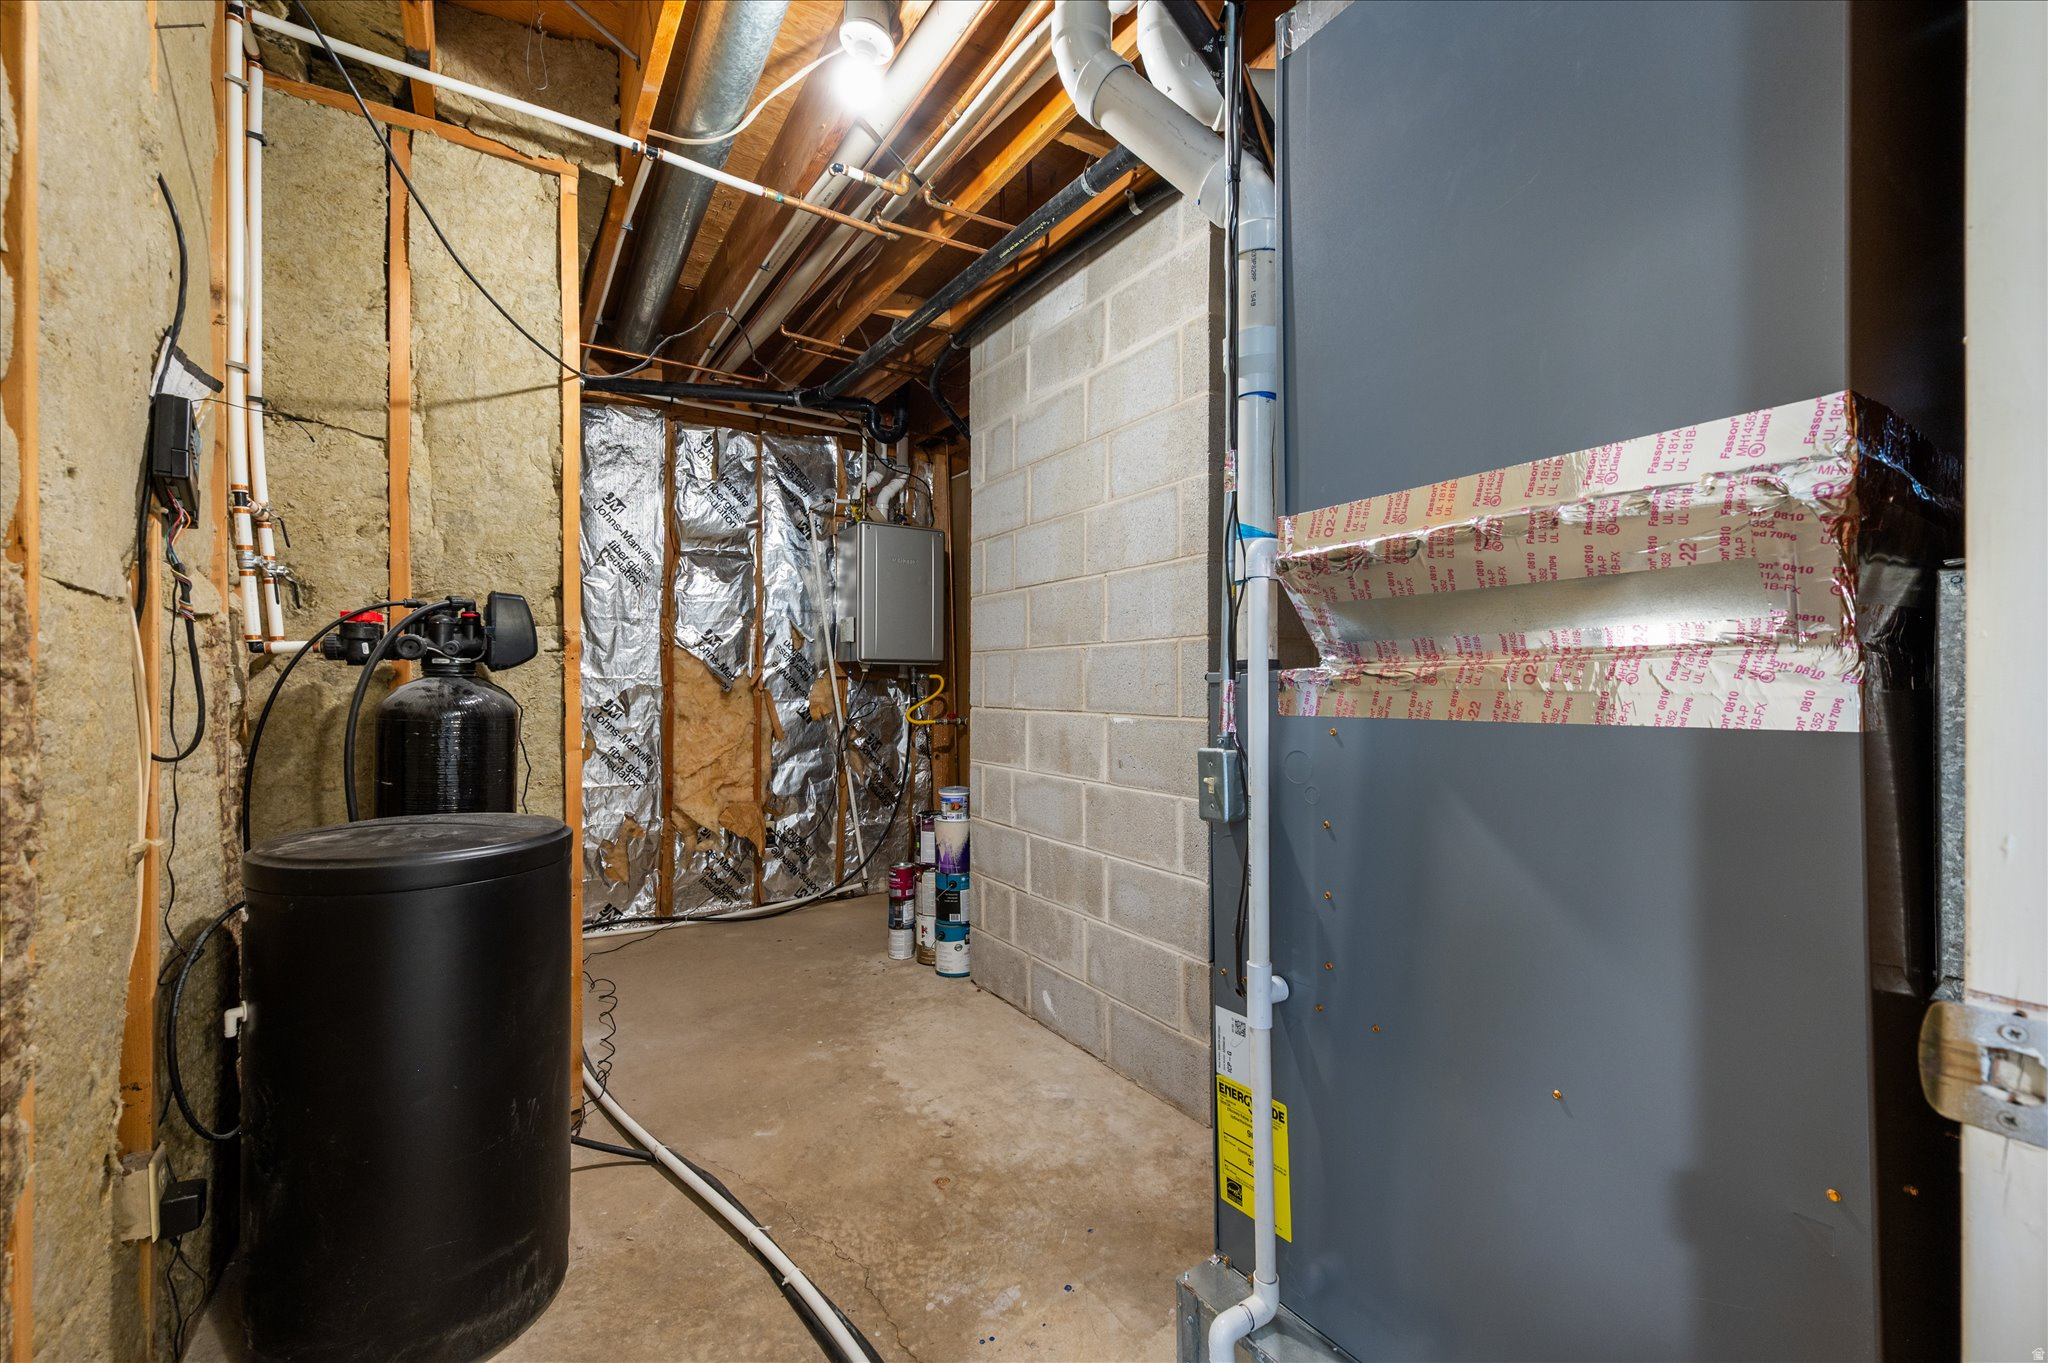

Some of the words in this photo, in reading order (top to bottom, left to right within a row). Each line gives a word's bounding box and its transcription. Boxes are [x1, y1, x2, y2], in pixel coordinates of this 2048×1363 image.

[1662, 458, 1675, 471] UL
[1677, 458, 1689, 471] UL
[1536, 483, 1546, 496] UL
[1548, 484, 1558, 496] UL
[1773, 511, 1804, 521] 0810
[592, 503, 655, 567] Johns-Manville
[1770, 531, 1797, 541] 70P6
[608, 540, 630, 563] fiber
[627, 558, 650, 584] glass
[1782, 563, 1814, 574] 0810
[1658, 690, 1671, 710] 0810
[1682, 697, 1694, 717] 70P6
[1724, 691, 1739, 713] 0810
[1800, 690, 1816, 713] 0810
[1829, 697, 1845, 720] 70P6
[591, 711, 654, 767] Johns-Manville
[608, 746, 630, 770] fiber
[627, 764, 650, 788] glass
[1219, 1081, 1252, 1107] ENERG
